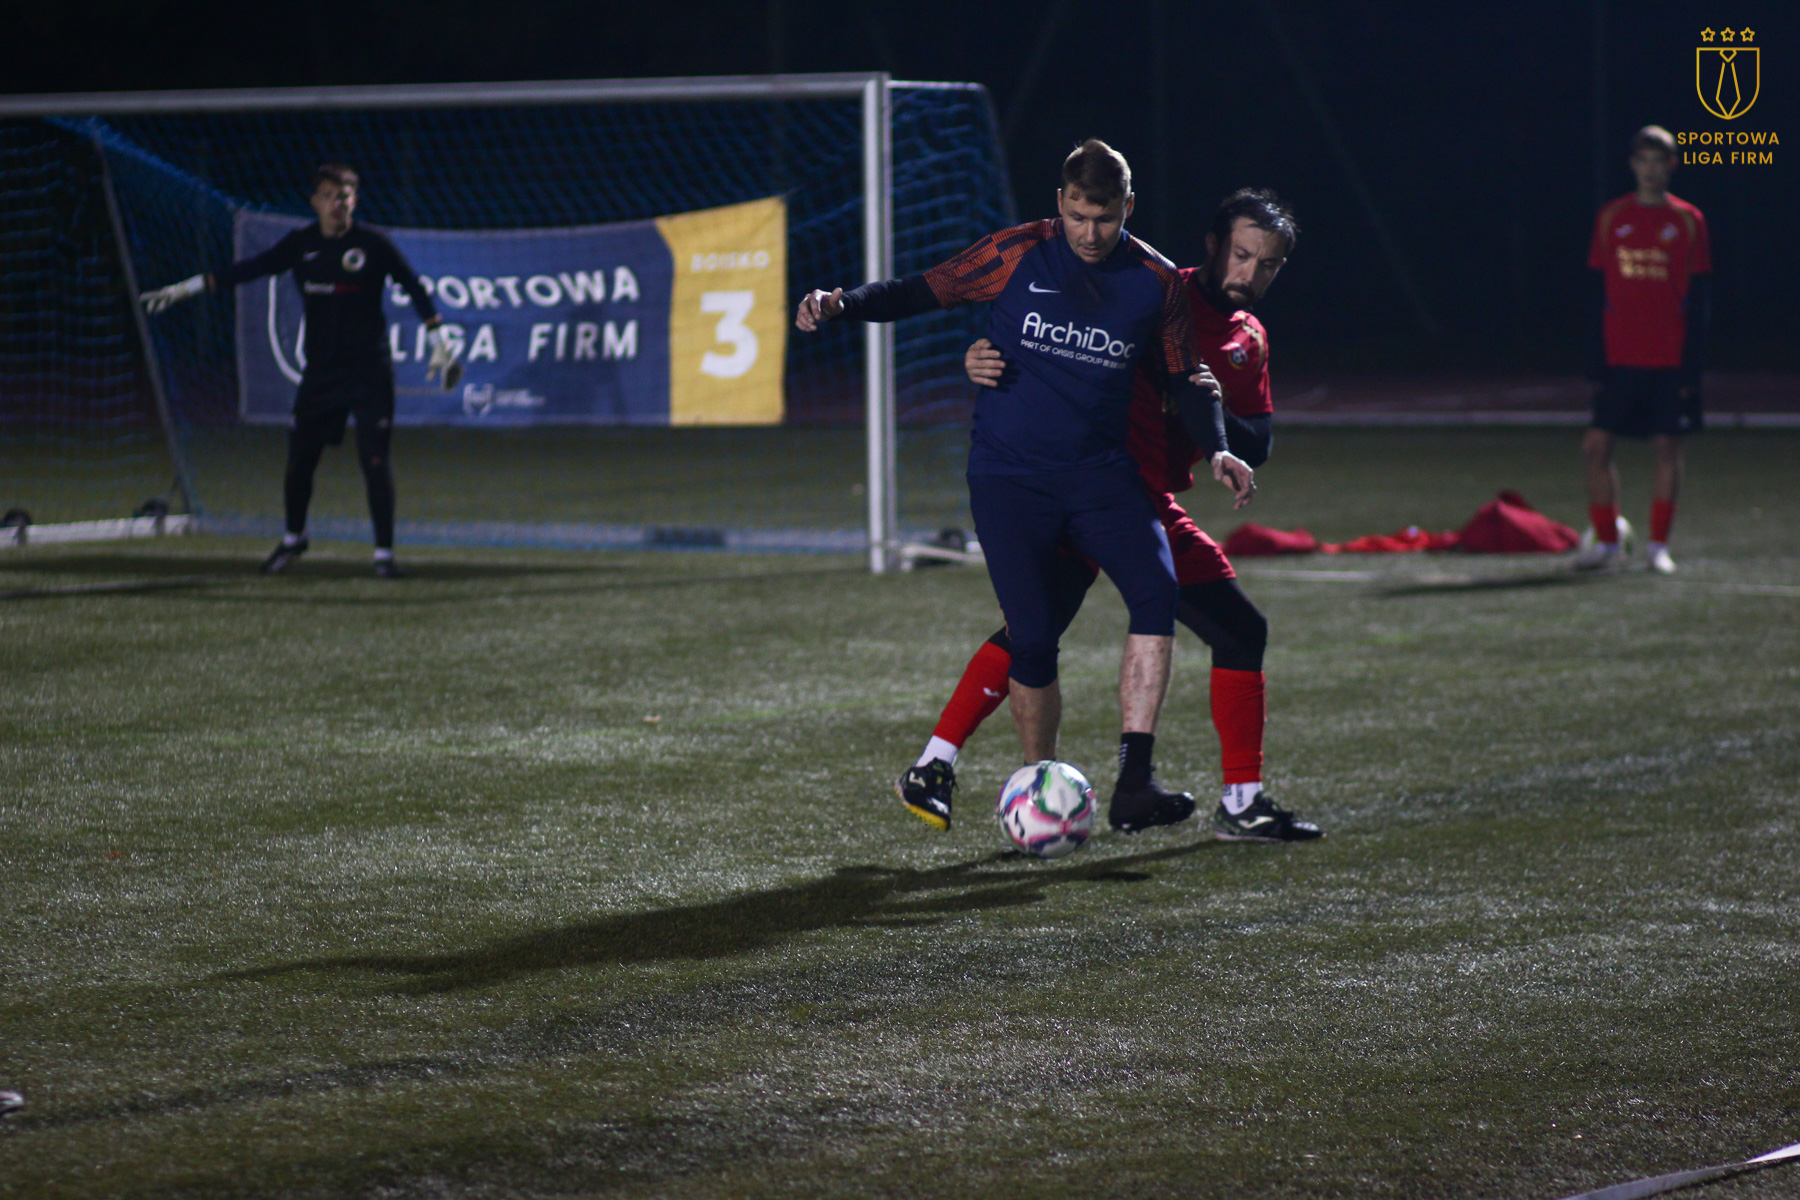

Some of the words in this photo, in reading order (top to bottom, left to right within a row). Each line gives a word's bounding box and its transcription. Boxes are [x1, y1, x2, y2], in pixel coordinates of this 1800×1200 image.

[527, 319, 640, 362] FIRM
[700, 289, 760, 379] 3
[1020, 338, 1040, 351] PART
[1039, 344, 1052, 353] OF
[1051, 346, 1075, 360] OASIS
[1075, 352, 1103, 365] GROUP
[1021, 311, 1136, 359] ArchiDoc
